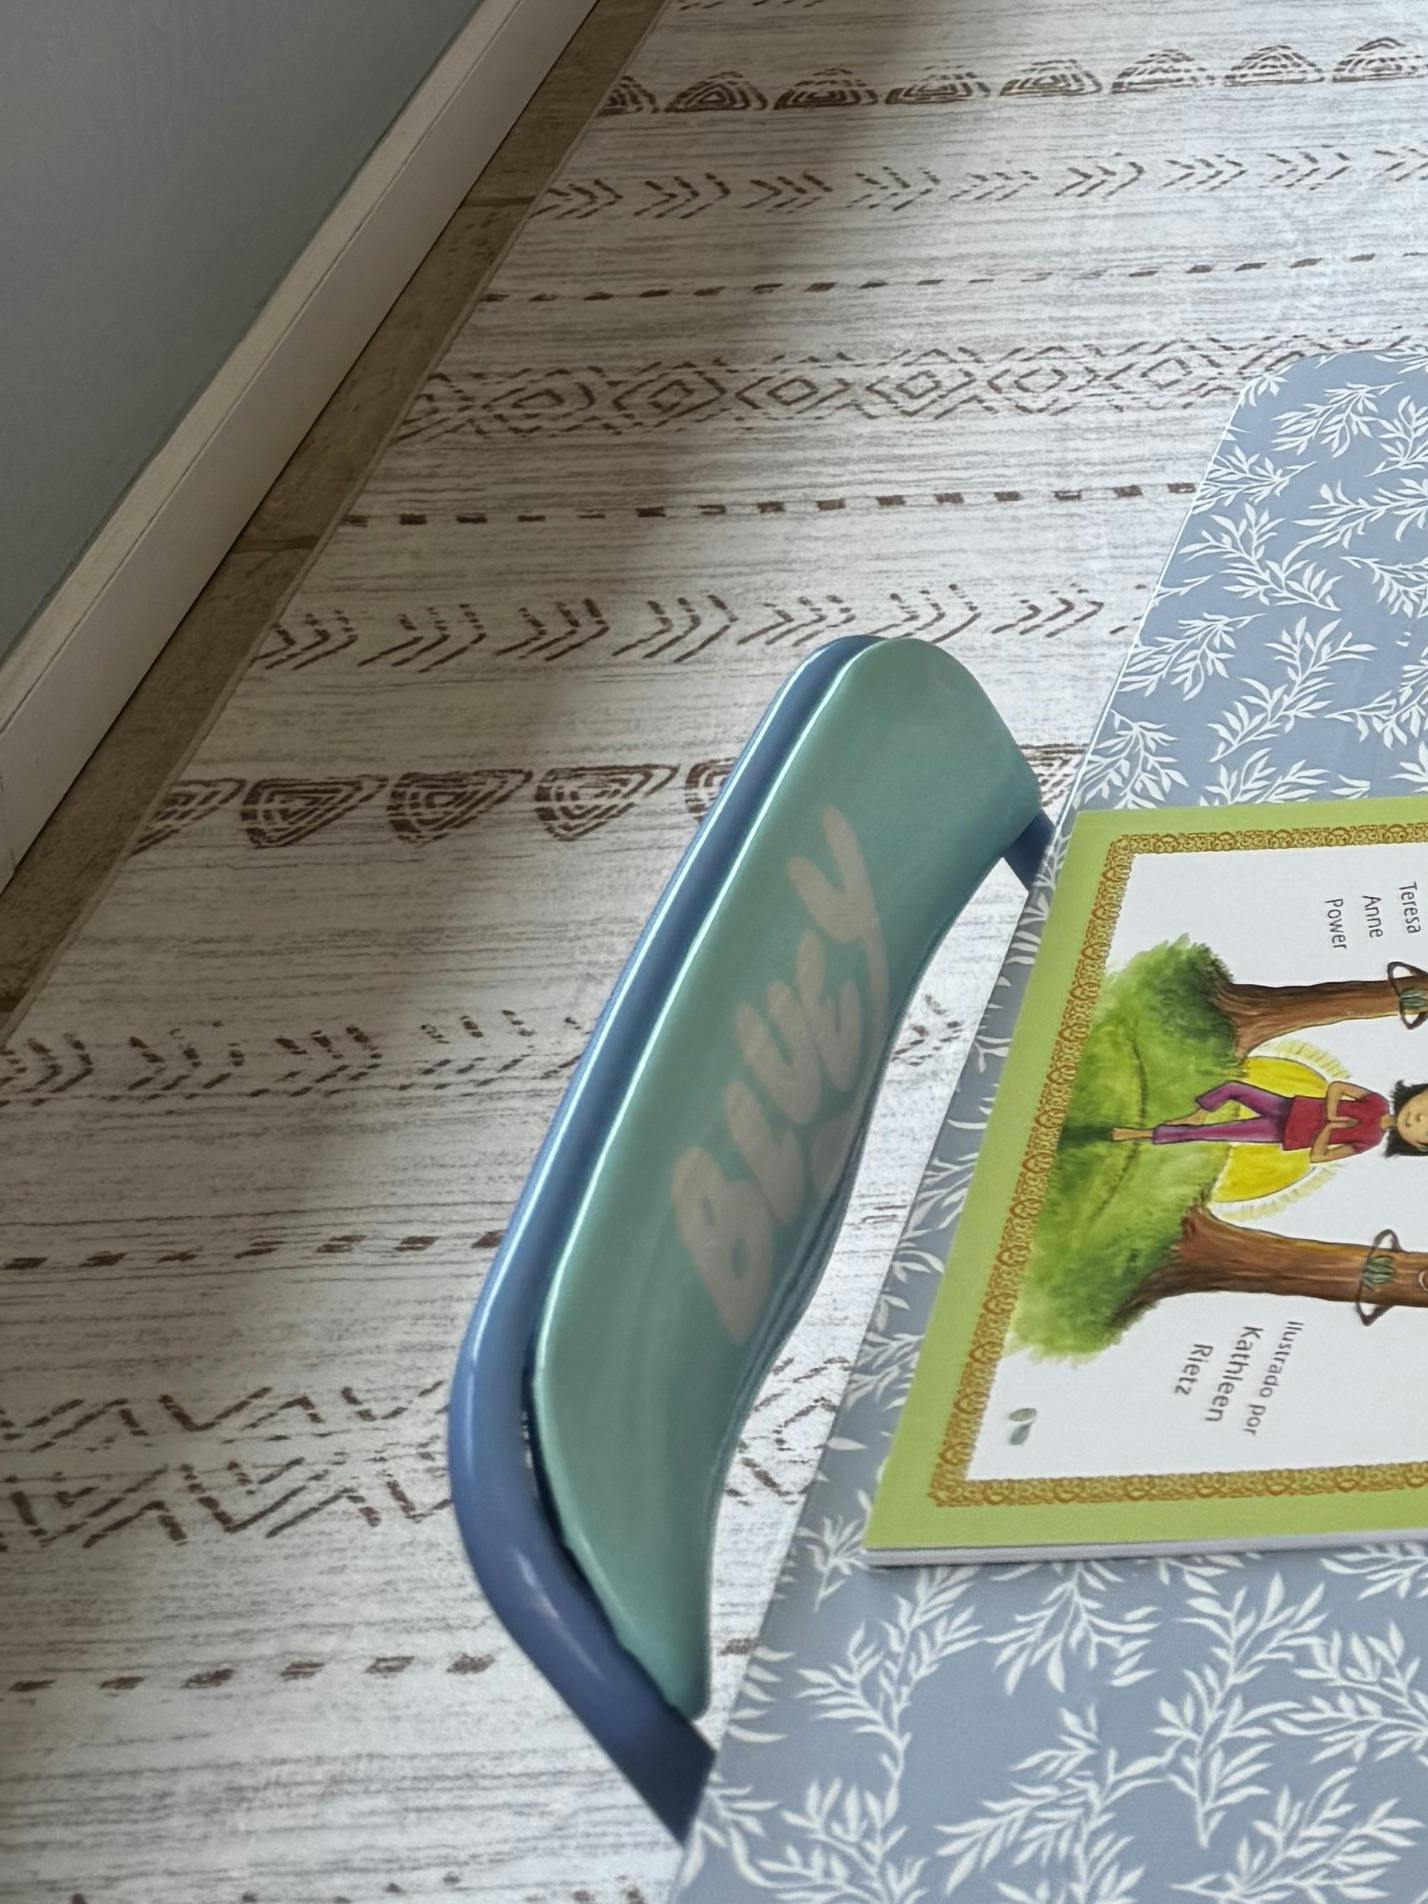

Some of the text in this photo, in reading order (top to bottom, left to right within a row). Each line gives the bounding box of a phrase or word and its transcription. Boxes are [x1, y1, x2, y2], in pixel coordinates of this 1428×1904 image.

[1325, 898, 1350, 951] Power
[1362, 895, 1386, 939] Anne
[1399, 881, 1423, 935] Teresa
[1173, 1343, 1214, 1397] Rietz
[1204, 1325, 1263, 1423] Kathleen
[1241, 1320, 1304, 1436] Ilustrado por
